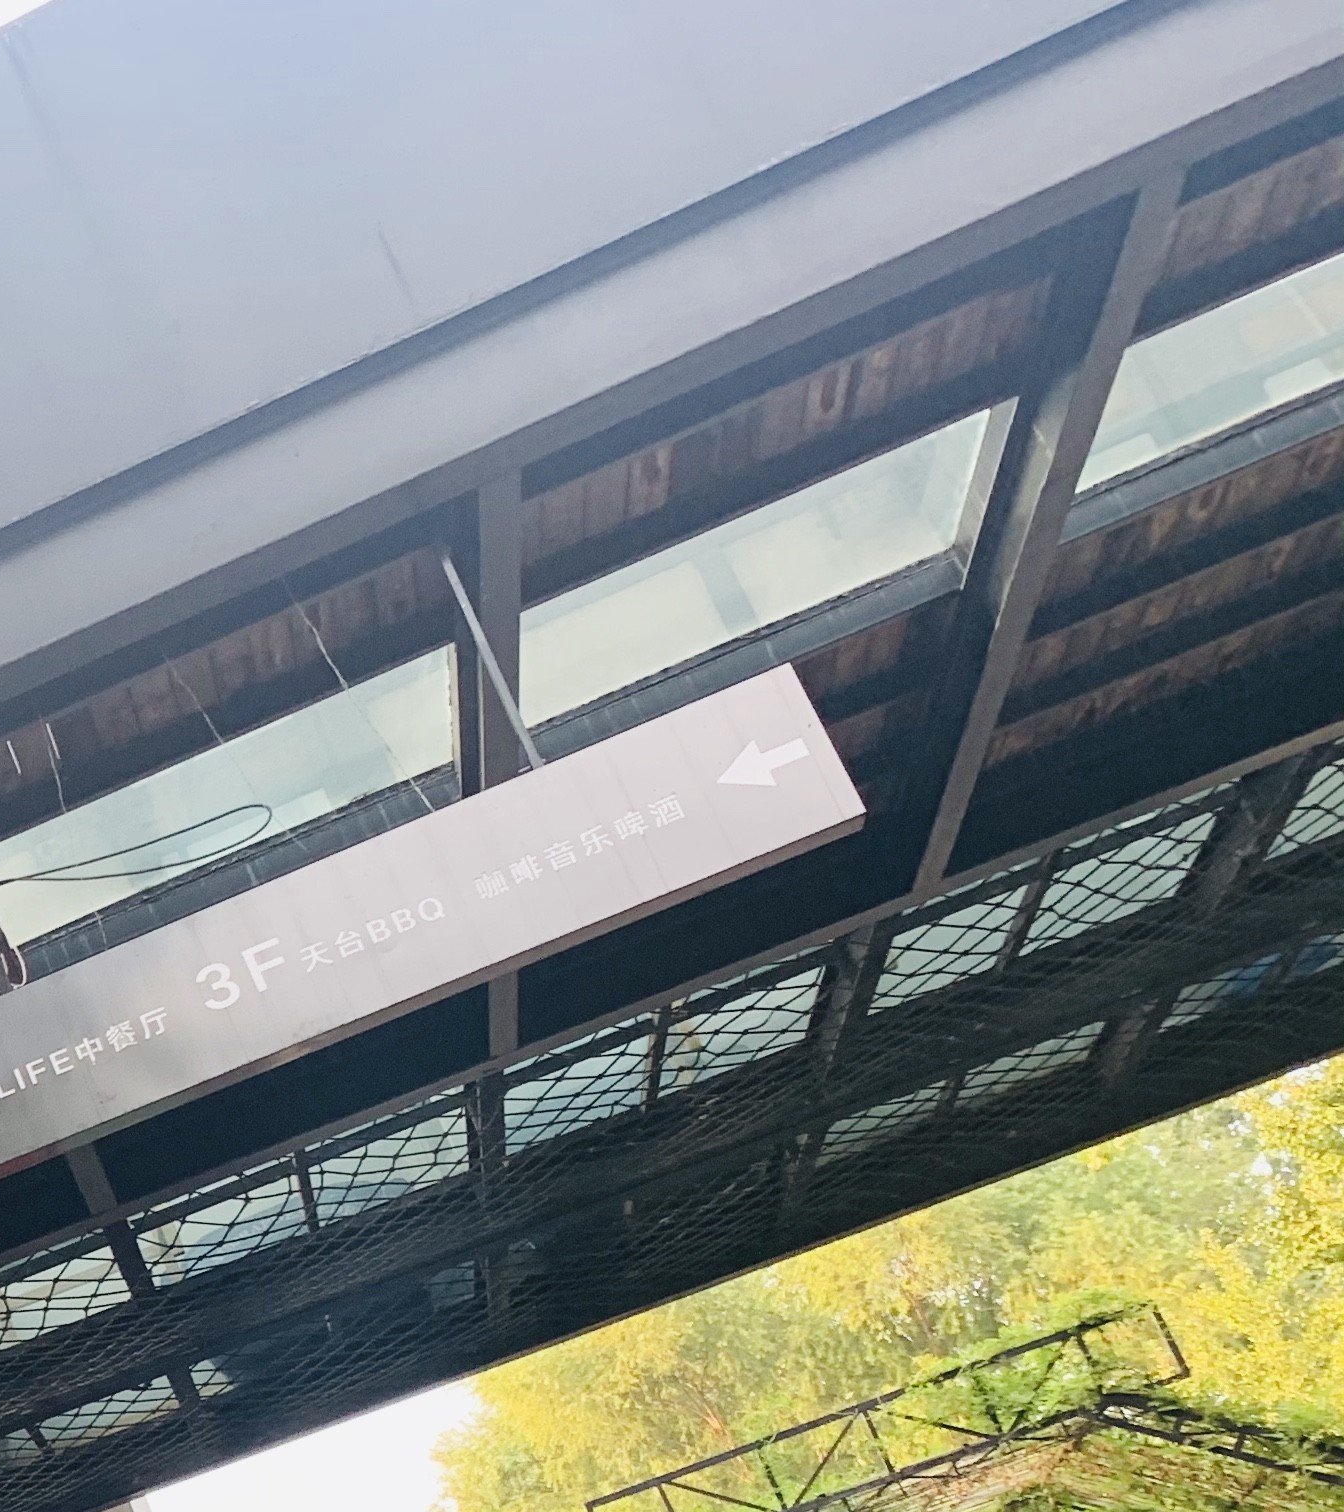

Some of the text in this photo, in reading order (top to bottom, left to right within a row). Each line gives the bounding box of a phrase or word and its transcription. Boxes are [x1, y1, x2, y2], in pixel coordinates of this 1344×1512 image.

[195, 937, 286, 1010] 3F
[298, 897, 447, 974] 天台BBQ
[473, 794, 686, 900] 咖啡音乐啤酒
